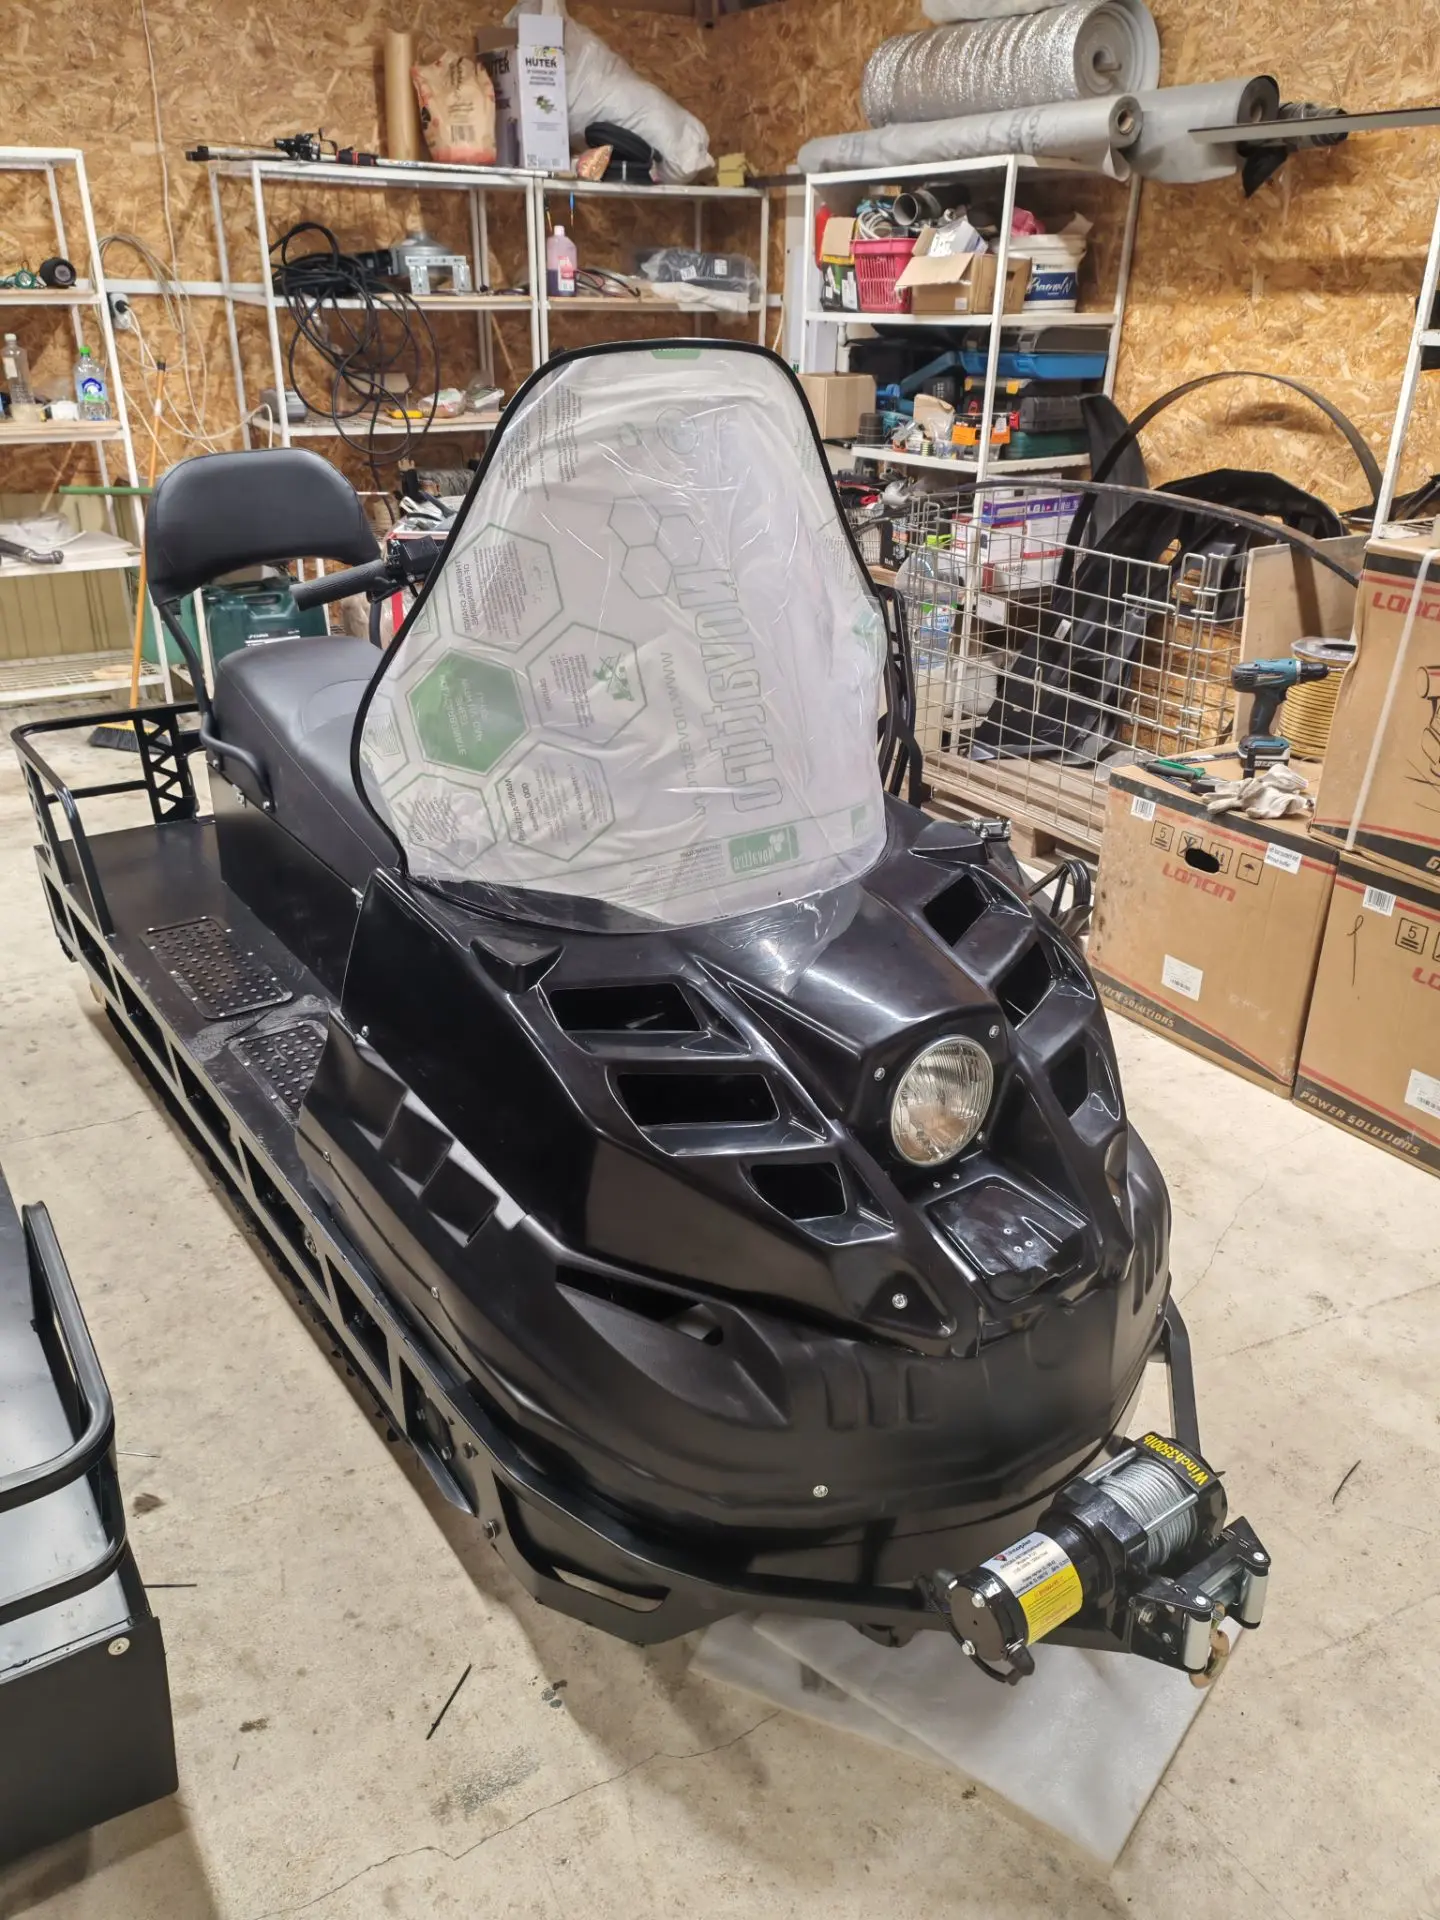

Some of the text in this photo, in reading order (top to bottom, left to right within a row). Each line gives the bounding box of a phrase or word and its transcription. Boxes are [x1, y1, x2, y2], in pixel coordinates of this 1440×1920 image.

[525, 57, 557, 69] HUTER
[1162, 862, 1237, 903] LONCIN
[1122, 996, 1175, 1028] SOLUTIONS
[1300, 1091, 1421, 1155] POWER SOLUTIONS
[1143, 1434, 1209, 1486] Winch3500lb
